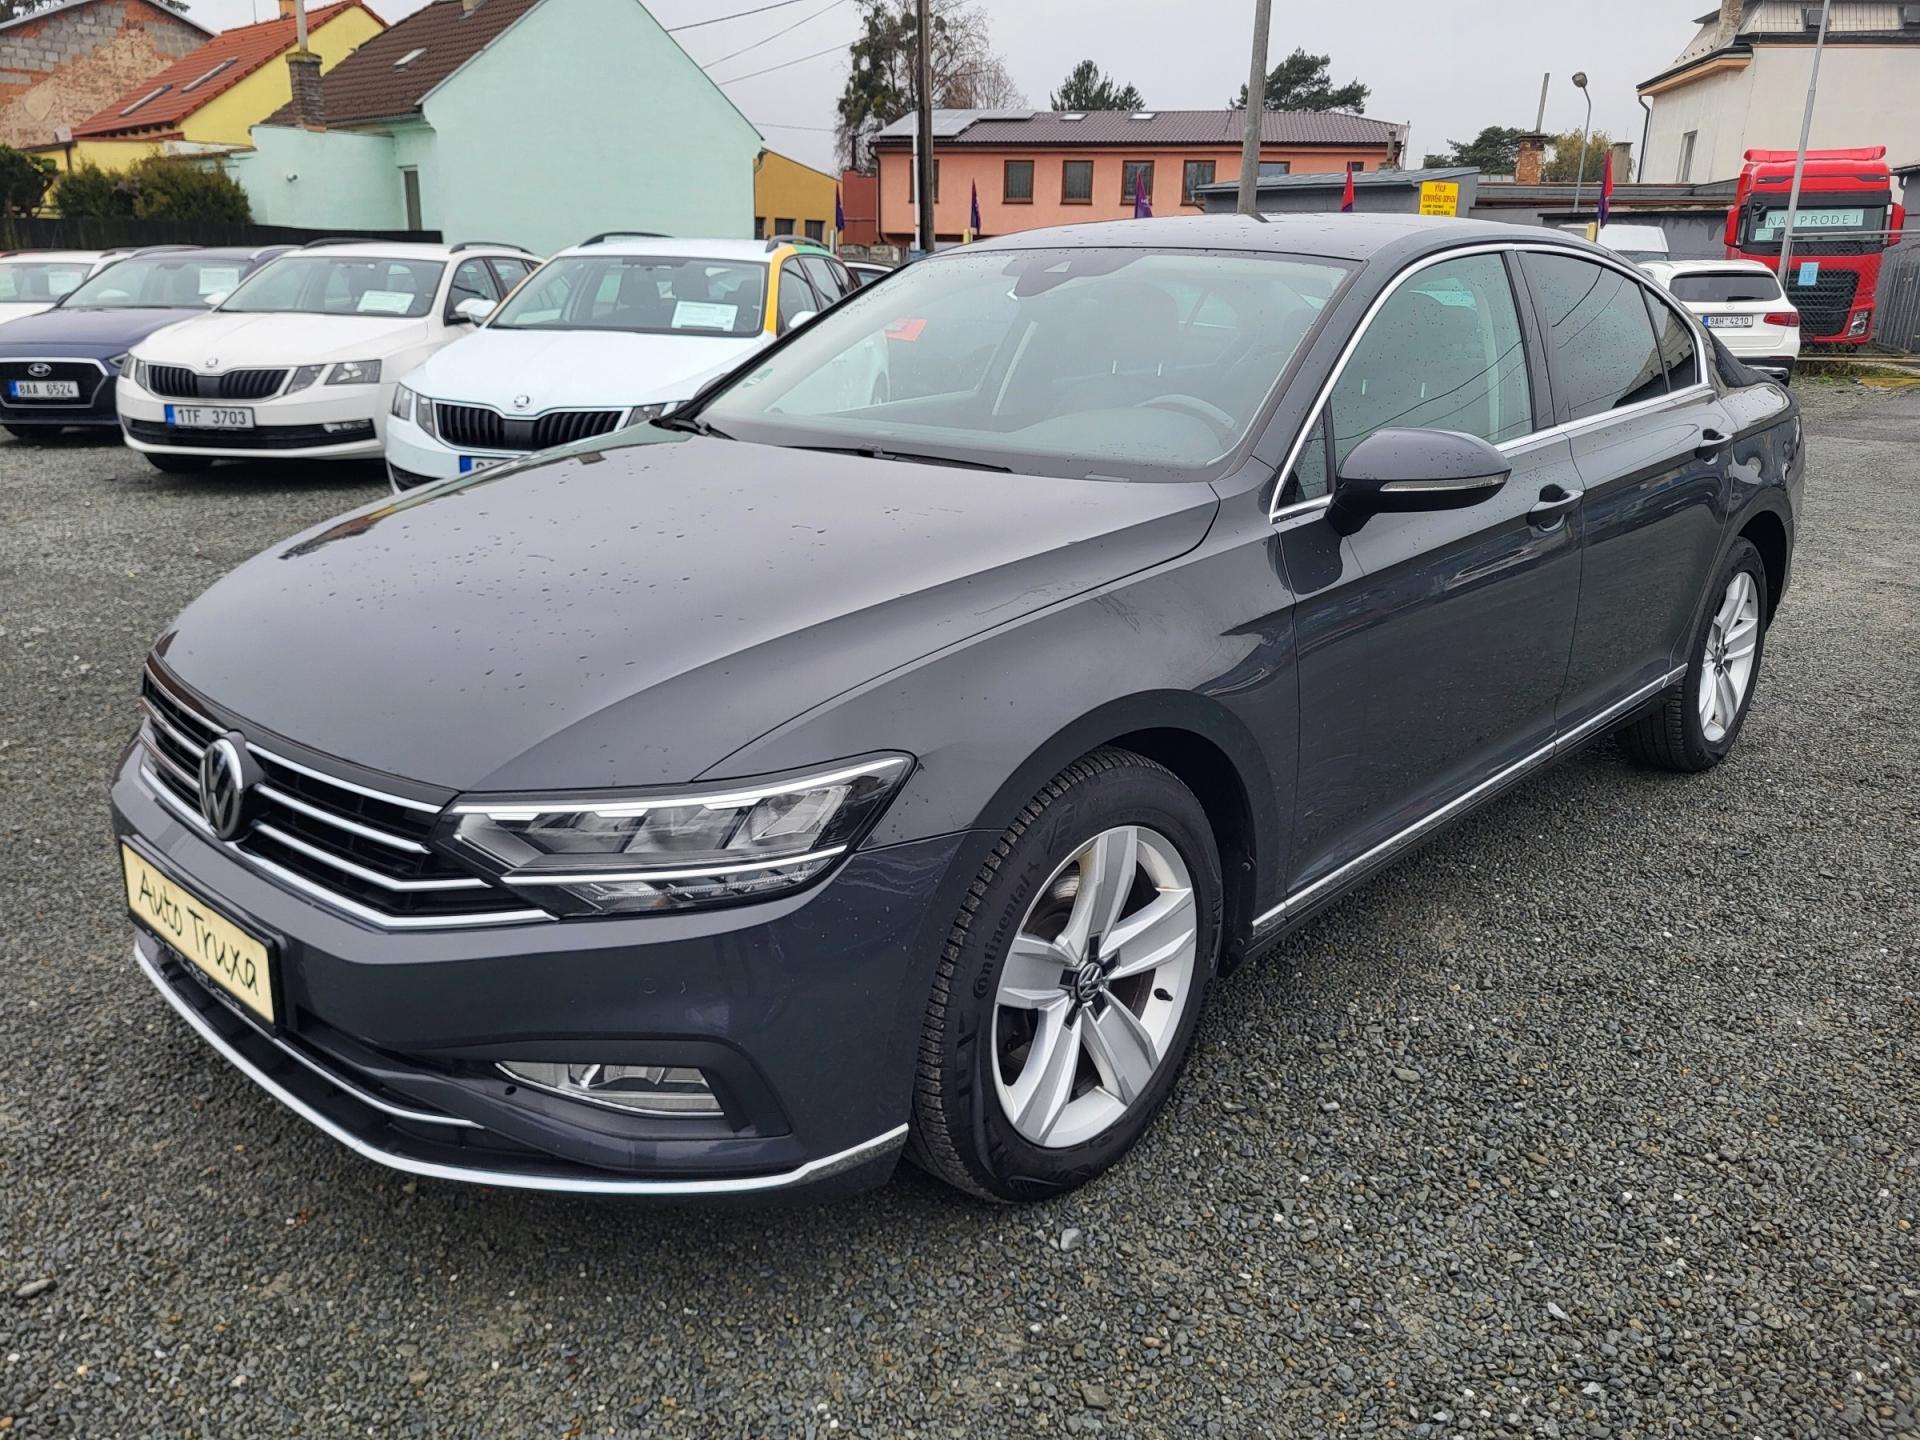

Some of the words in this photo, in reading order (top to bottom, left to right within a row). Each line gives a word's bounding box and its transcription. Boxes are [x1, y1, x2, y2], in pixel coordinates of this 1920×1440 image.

[1767, 215, 1788, 227] NA
[1799, 214, 1859, 226] PRODEJ
[1710, 317, 1725, 325] 9AH
[1729, 317, 1749, 325] 4210
[46, 383, 73, 394] 6524
[178, 408, 200, 423] 1TF
[212, 409, 247, 425] 3703
[139, 869, 183, 937] Auto
[187, 906, 259, 996] Truxa
